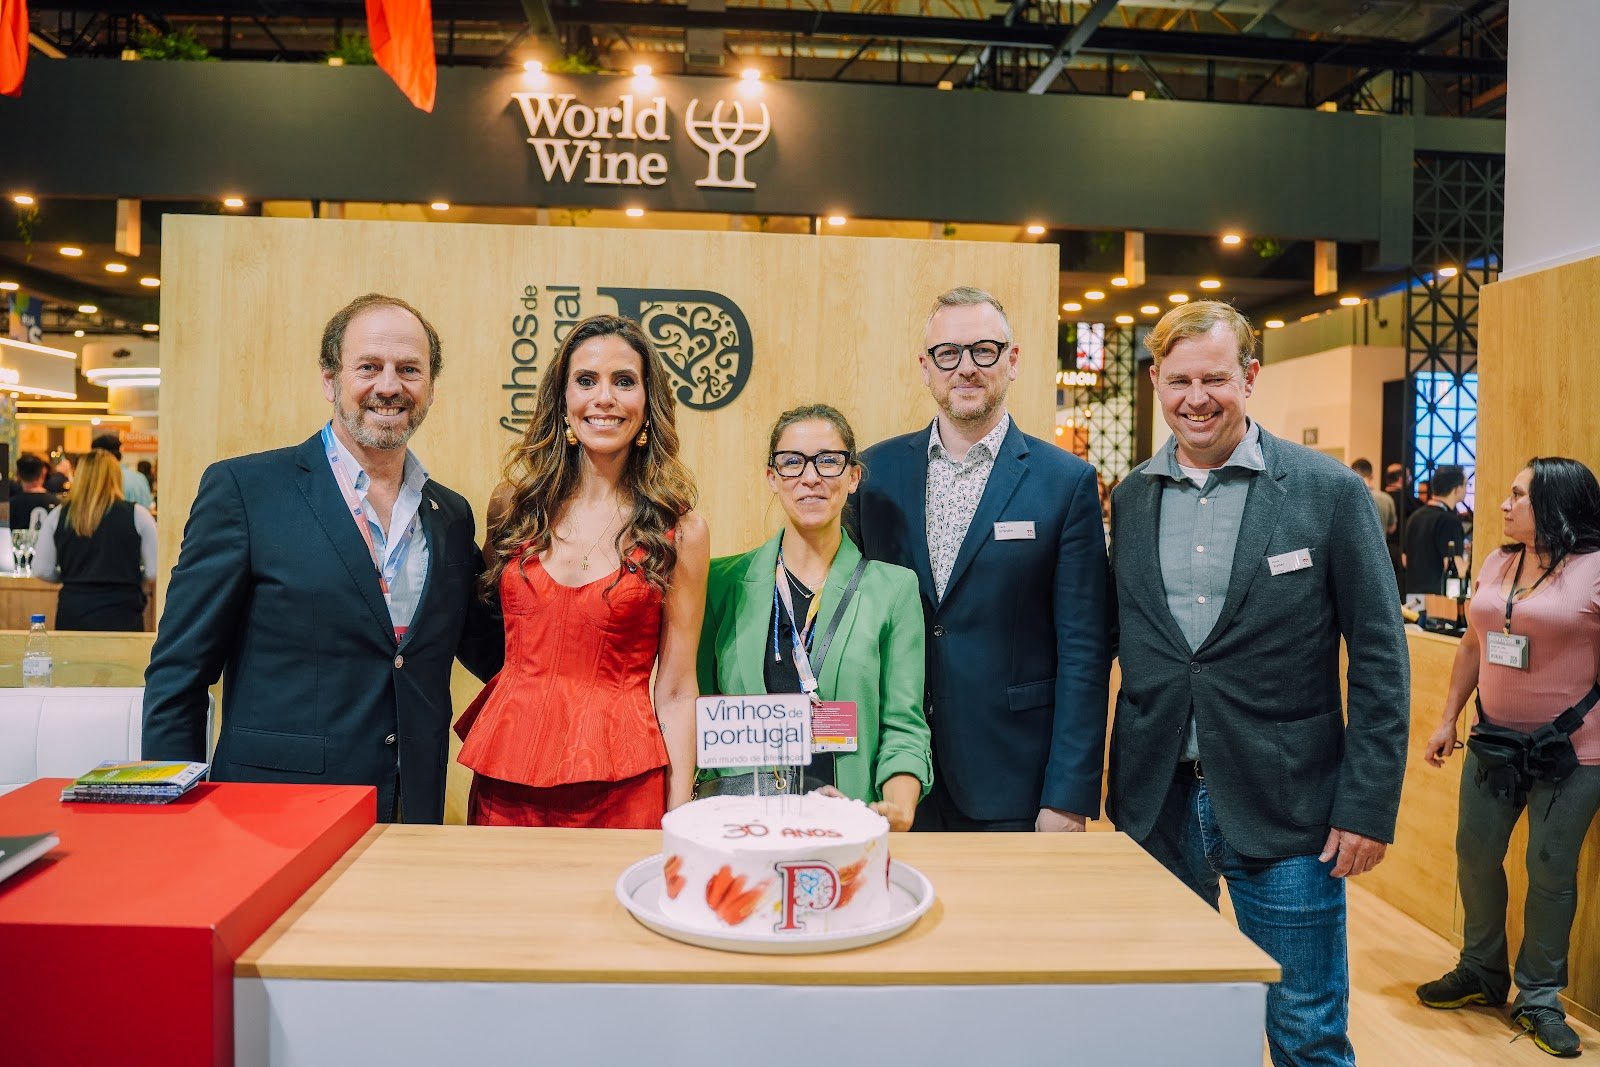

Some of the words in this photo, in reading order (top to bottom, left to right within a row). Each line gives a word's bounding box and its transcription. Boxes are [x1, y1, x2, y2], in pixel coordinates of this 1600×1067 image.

[511, 92, 670, 141] World
[526, 137, 668, 186] Wine
[520, 284, 538, 311] de
[705, 699, 786, 721] Vinhos
[788, 707, 803, 718] de
[703, 722, 804, 751] portugal
[723, 822, 768, 839] 30
[781, 827, 843, 839] ANOS
